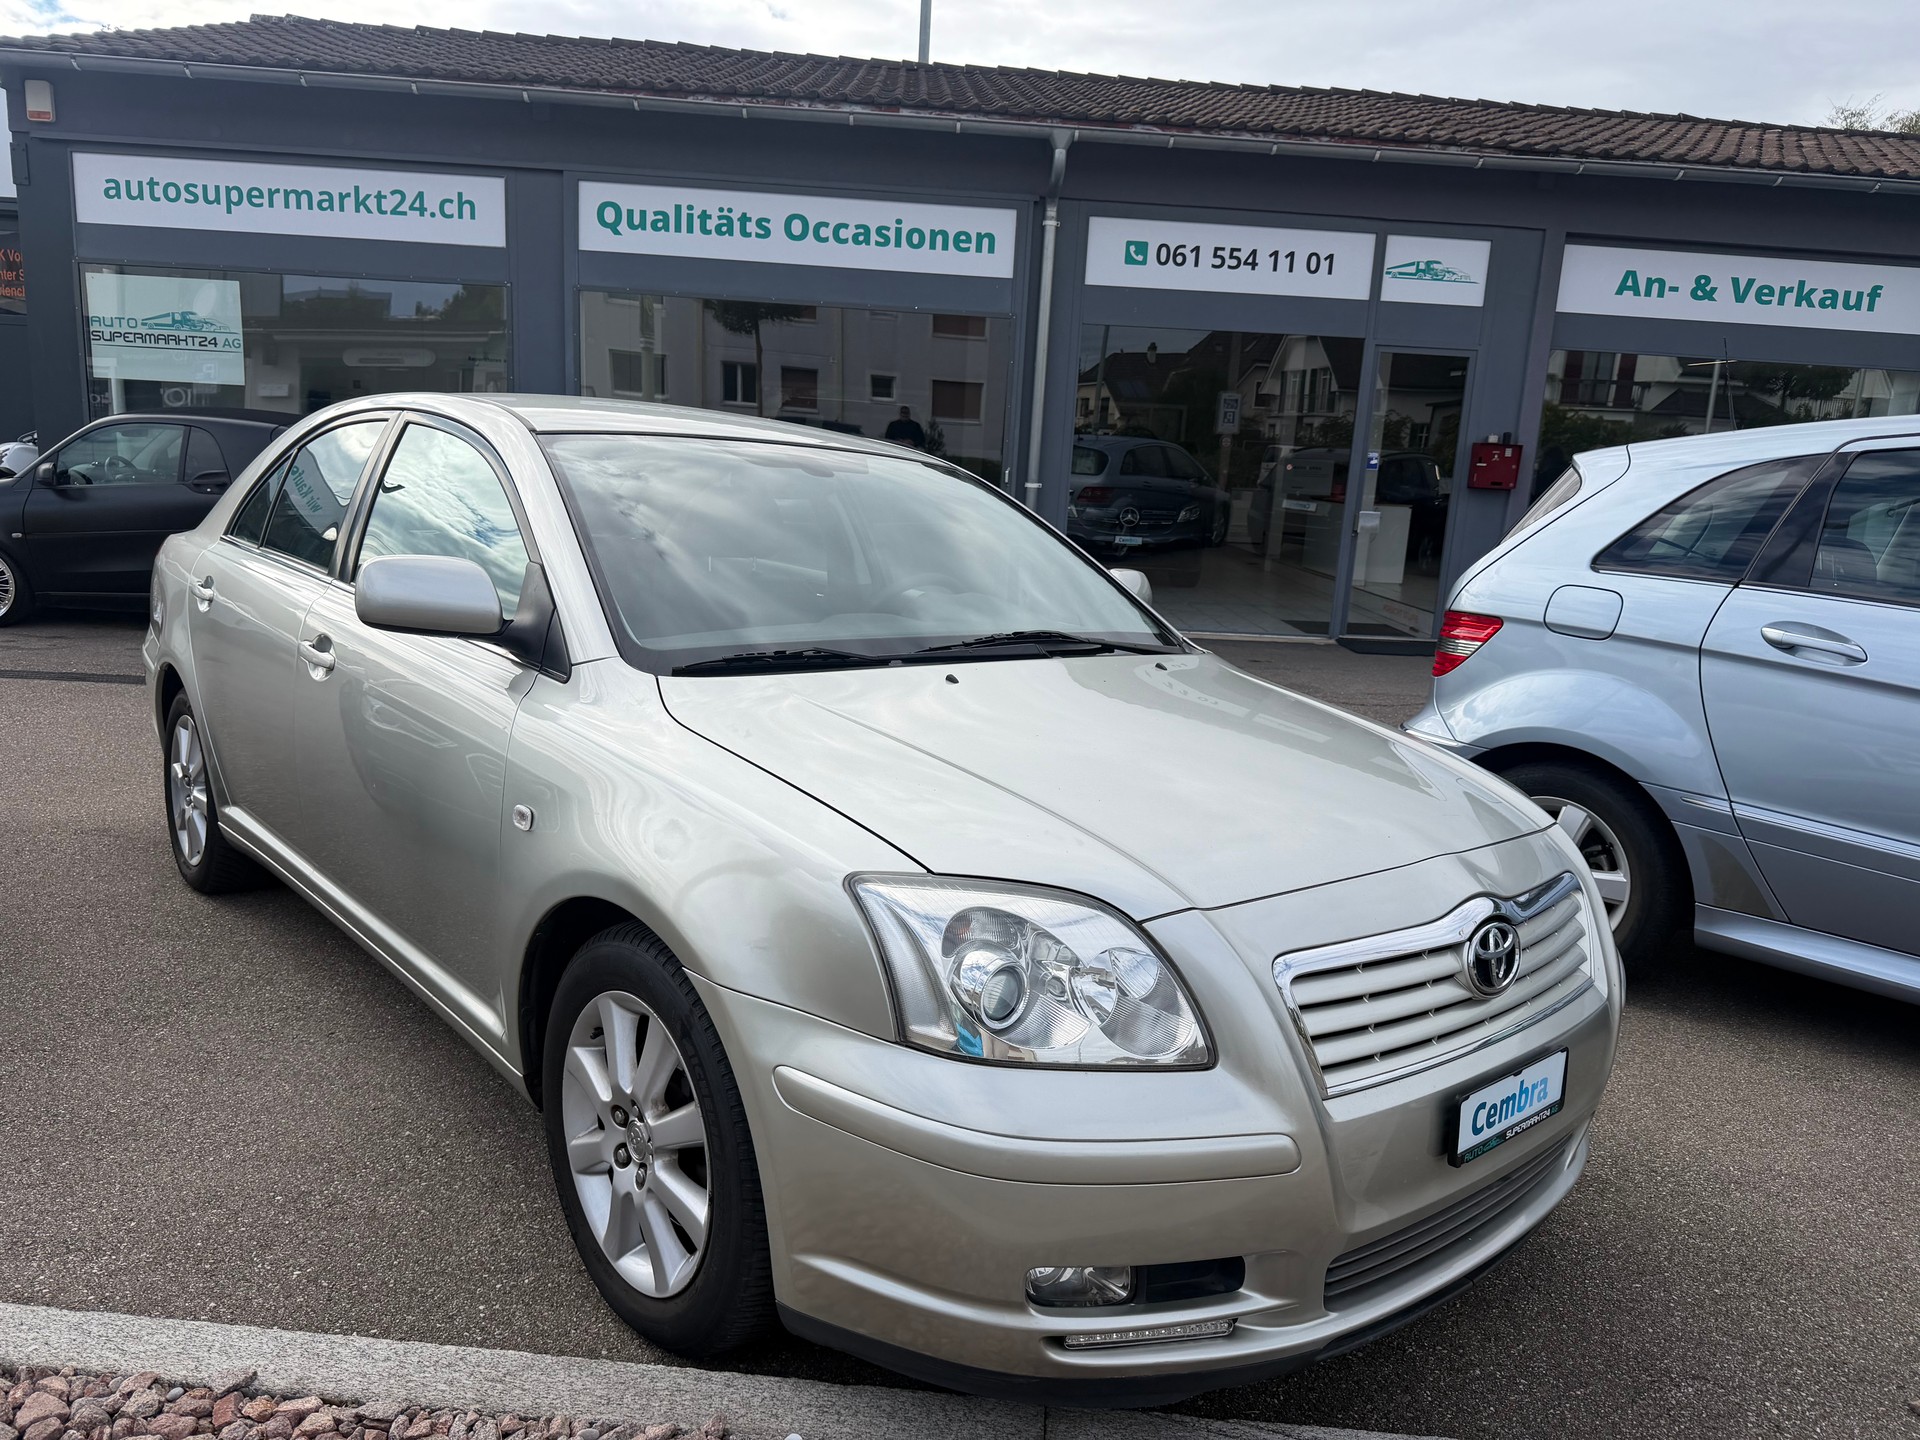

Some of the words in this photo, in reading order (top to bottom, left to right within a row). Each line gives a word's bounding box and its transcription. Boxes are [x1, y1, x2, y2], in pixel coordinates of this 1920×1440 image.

[103, 178, 476, 221] autosupermarkt24.ch
[596, 201, 772, 240] Qualitäts
[784, 213, 997, 255] Occasionen
[1155, 242, 1201, 268] 061
[1210, 246, 1259, 271] 554
[1268, 249, 1296, 273] 11
[1305, 251, 1335, 276] 01
[1615, 270, 1679, 299] An-
[1690, 274, 1718, 302] &
[1731, 277, 1884, 313] Verkauf
[90, 315, 138, 329] AUTO
[90, 330, 218, 348] SUPERMARKT24
[222, 338, 242, 349] AG
[1471, 1076, 1549, 1137] Cembra
